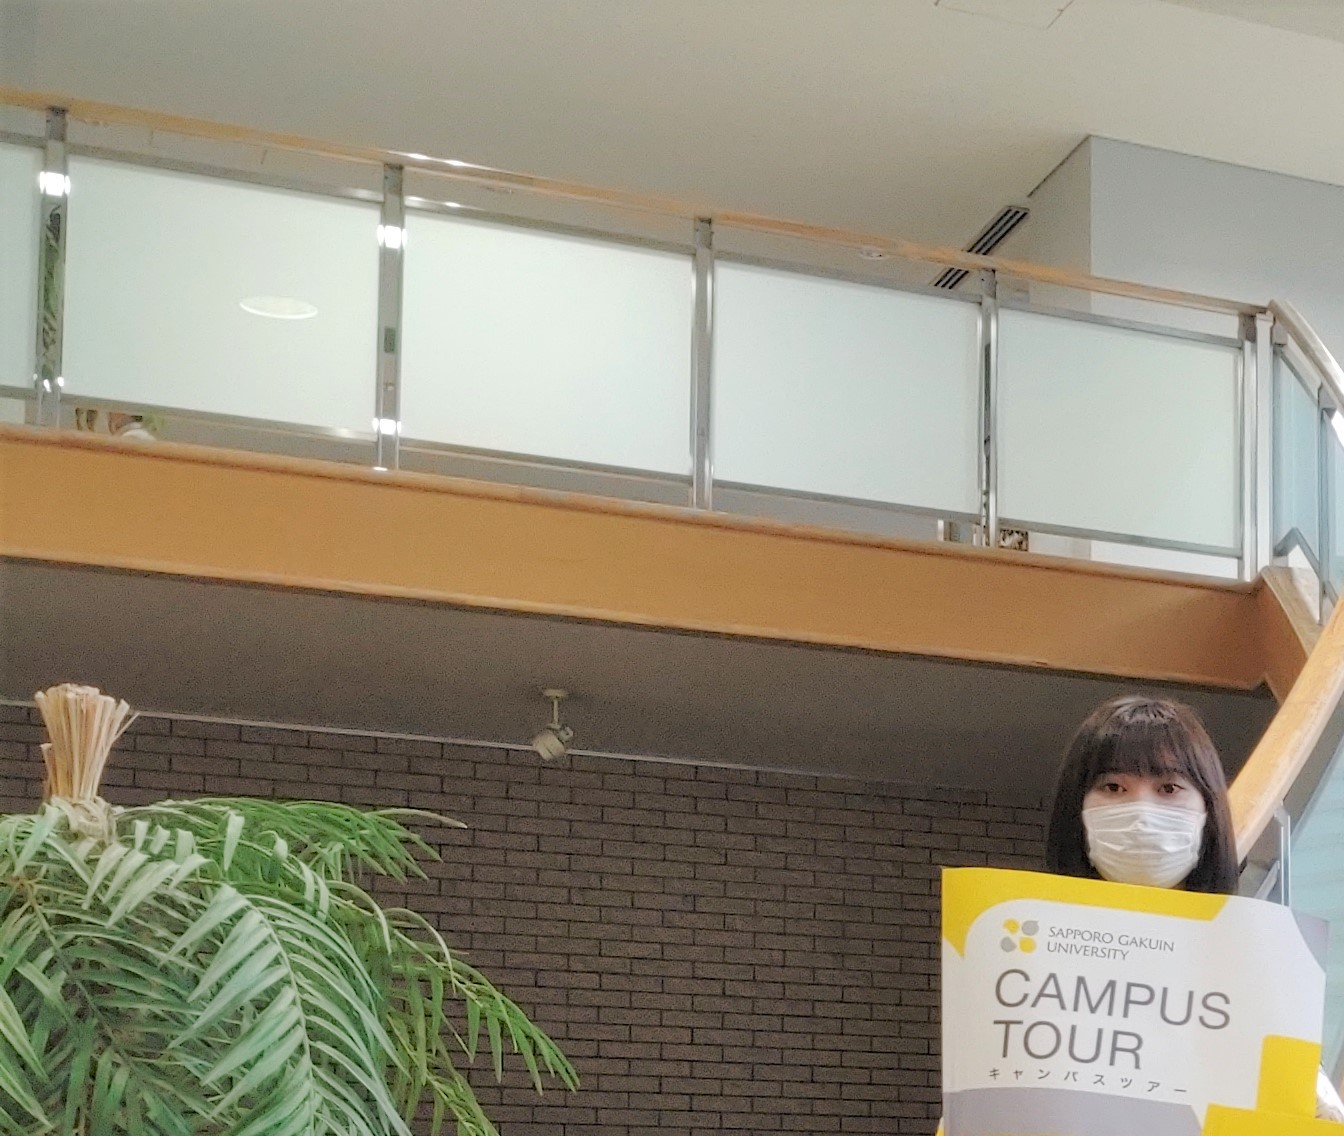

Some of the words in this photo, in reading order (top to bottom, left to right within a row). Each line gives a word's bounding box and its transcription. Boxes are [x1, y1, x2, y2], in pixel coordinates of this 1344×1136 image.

[1046, 942, 1130, 961] UNIVERSITY
[1048, 926, 1114, 945] SAPPORO
[1117, 933, 1175, 953] GAKUIN
[994, 968, 1232, 1031] CAMPUS
[992, 1018, 1145, 1071] TOUR
